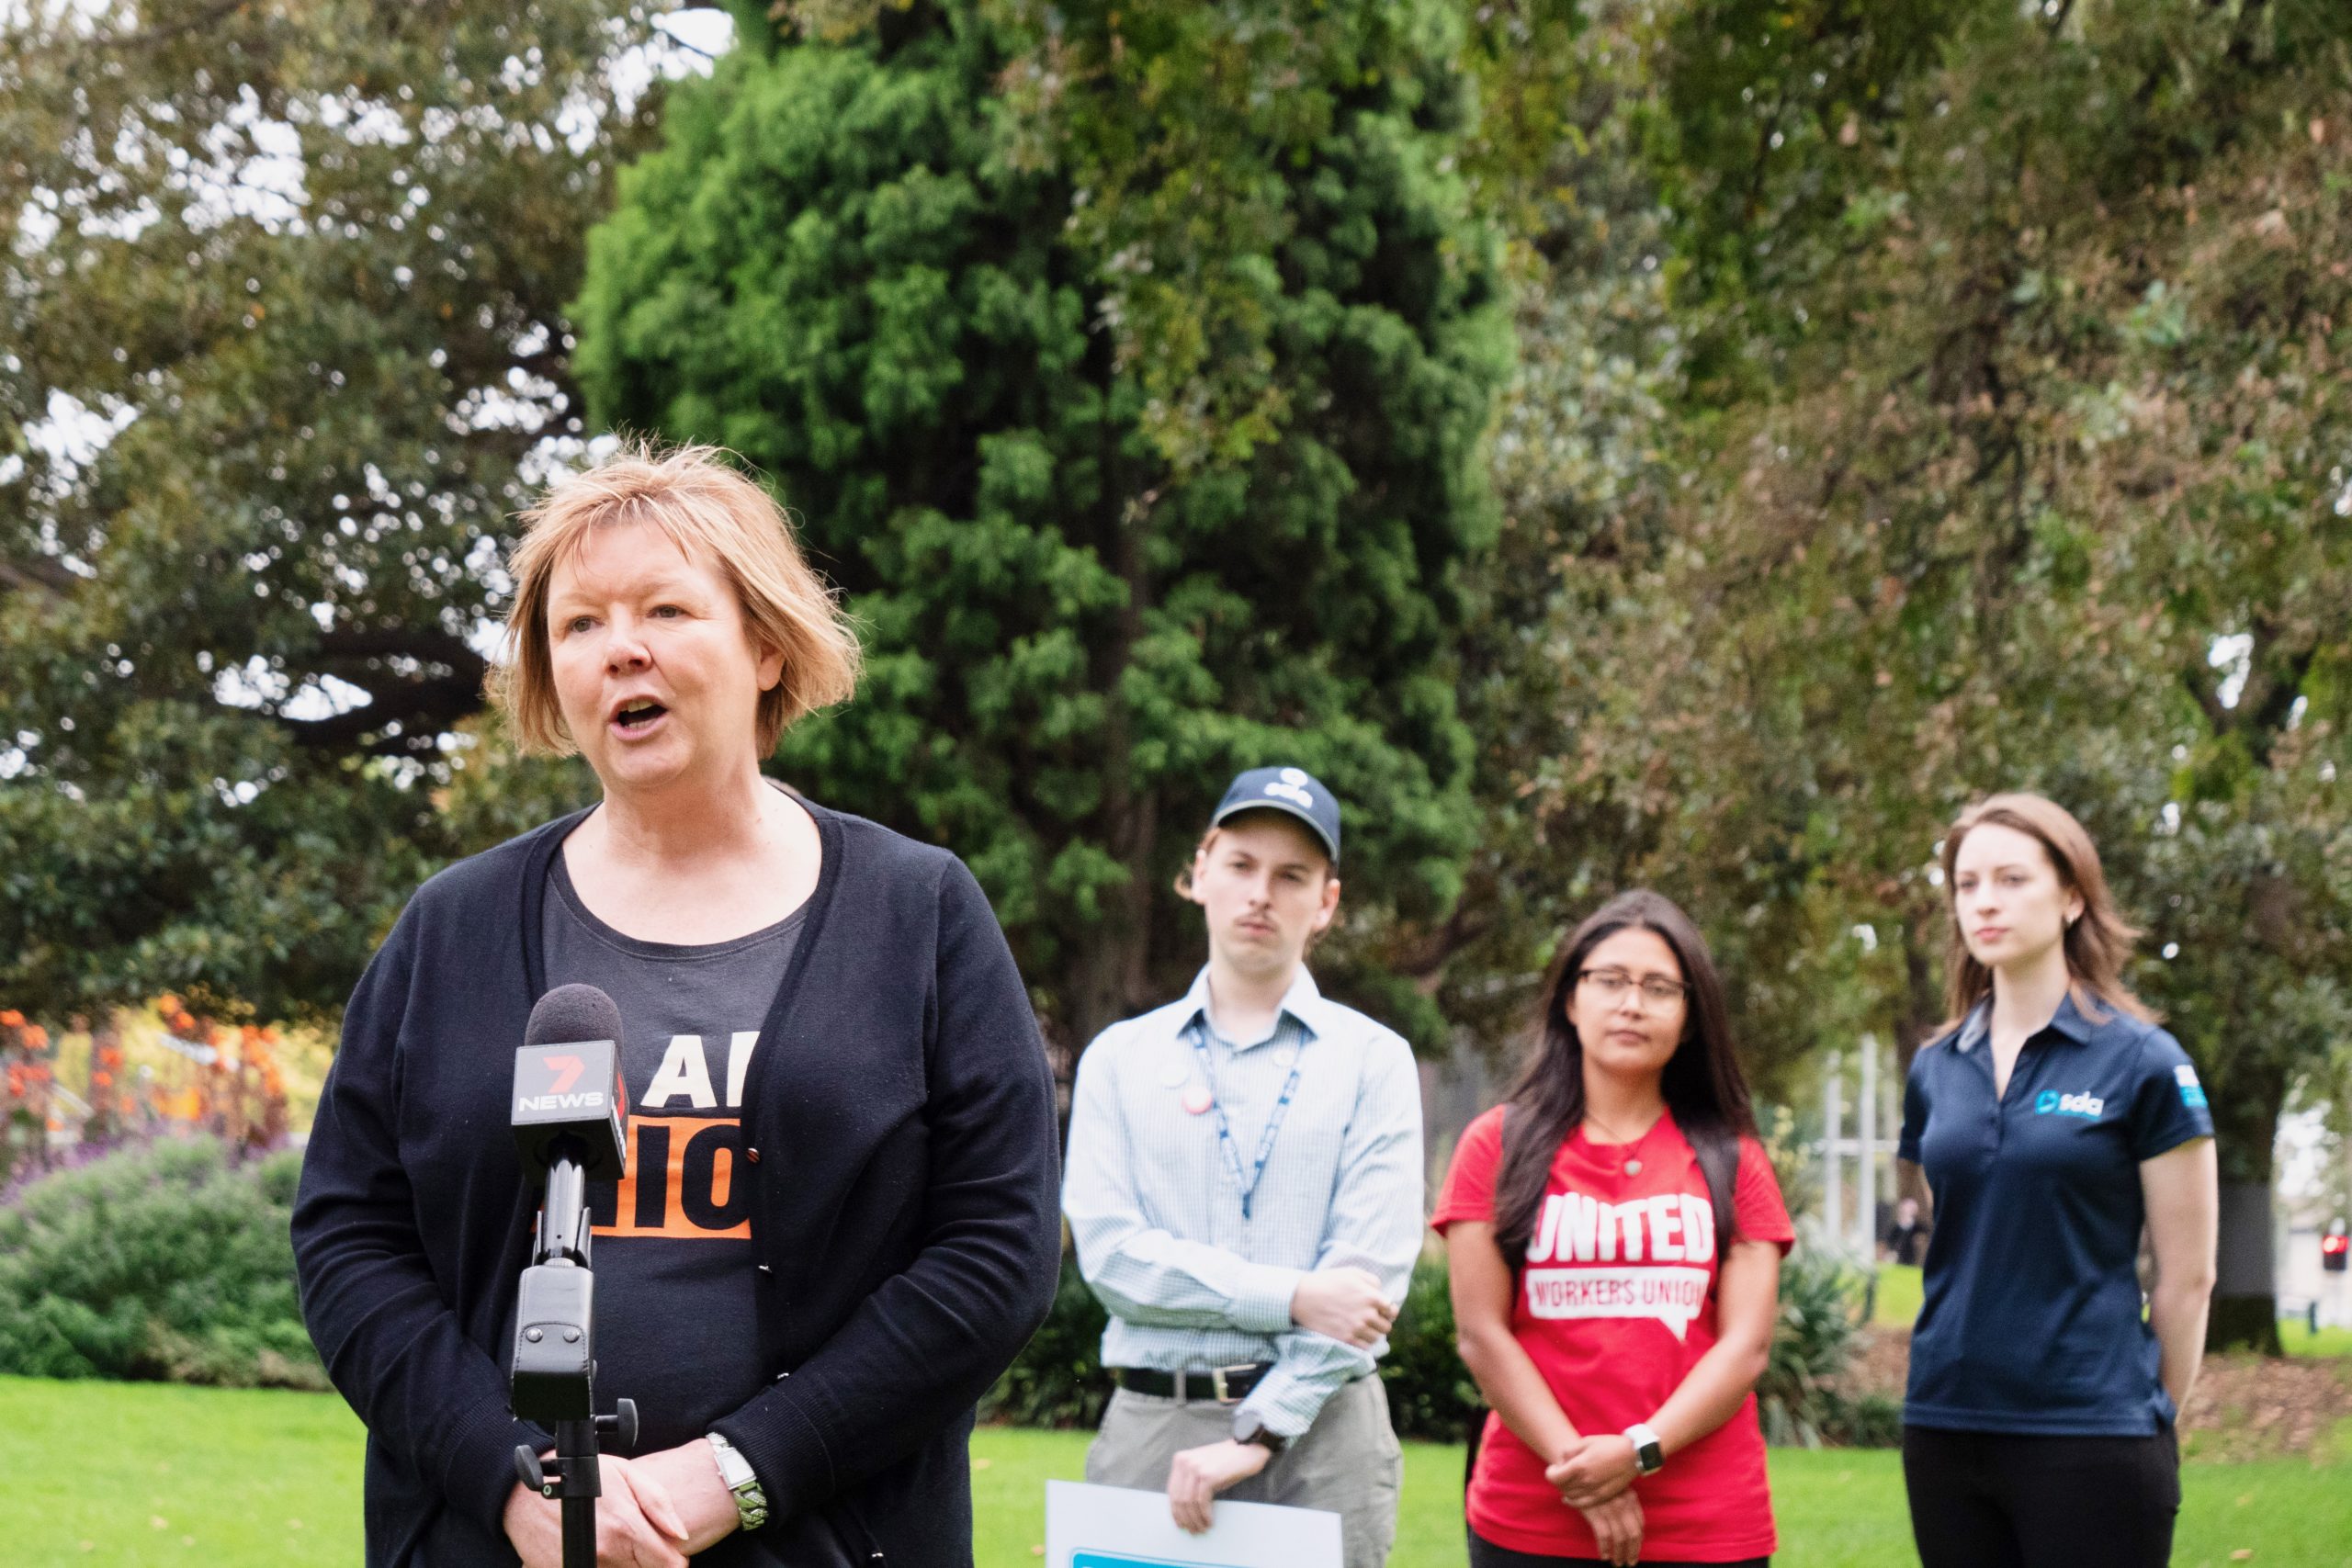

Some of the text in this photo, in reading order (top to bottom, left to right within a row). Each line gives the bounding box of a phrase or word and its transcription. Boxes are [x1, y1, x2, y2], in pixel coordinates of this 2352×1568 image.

[543, 1055, 585, 1094] 7
[518, 1091, 604, 1112] NEWS
[1534, 1279, 1634, 1307] WORKERS
